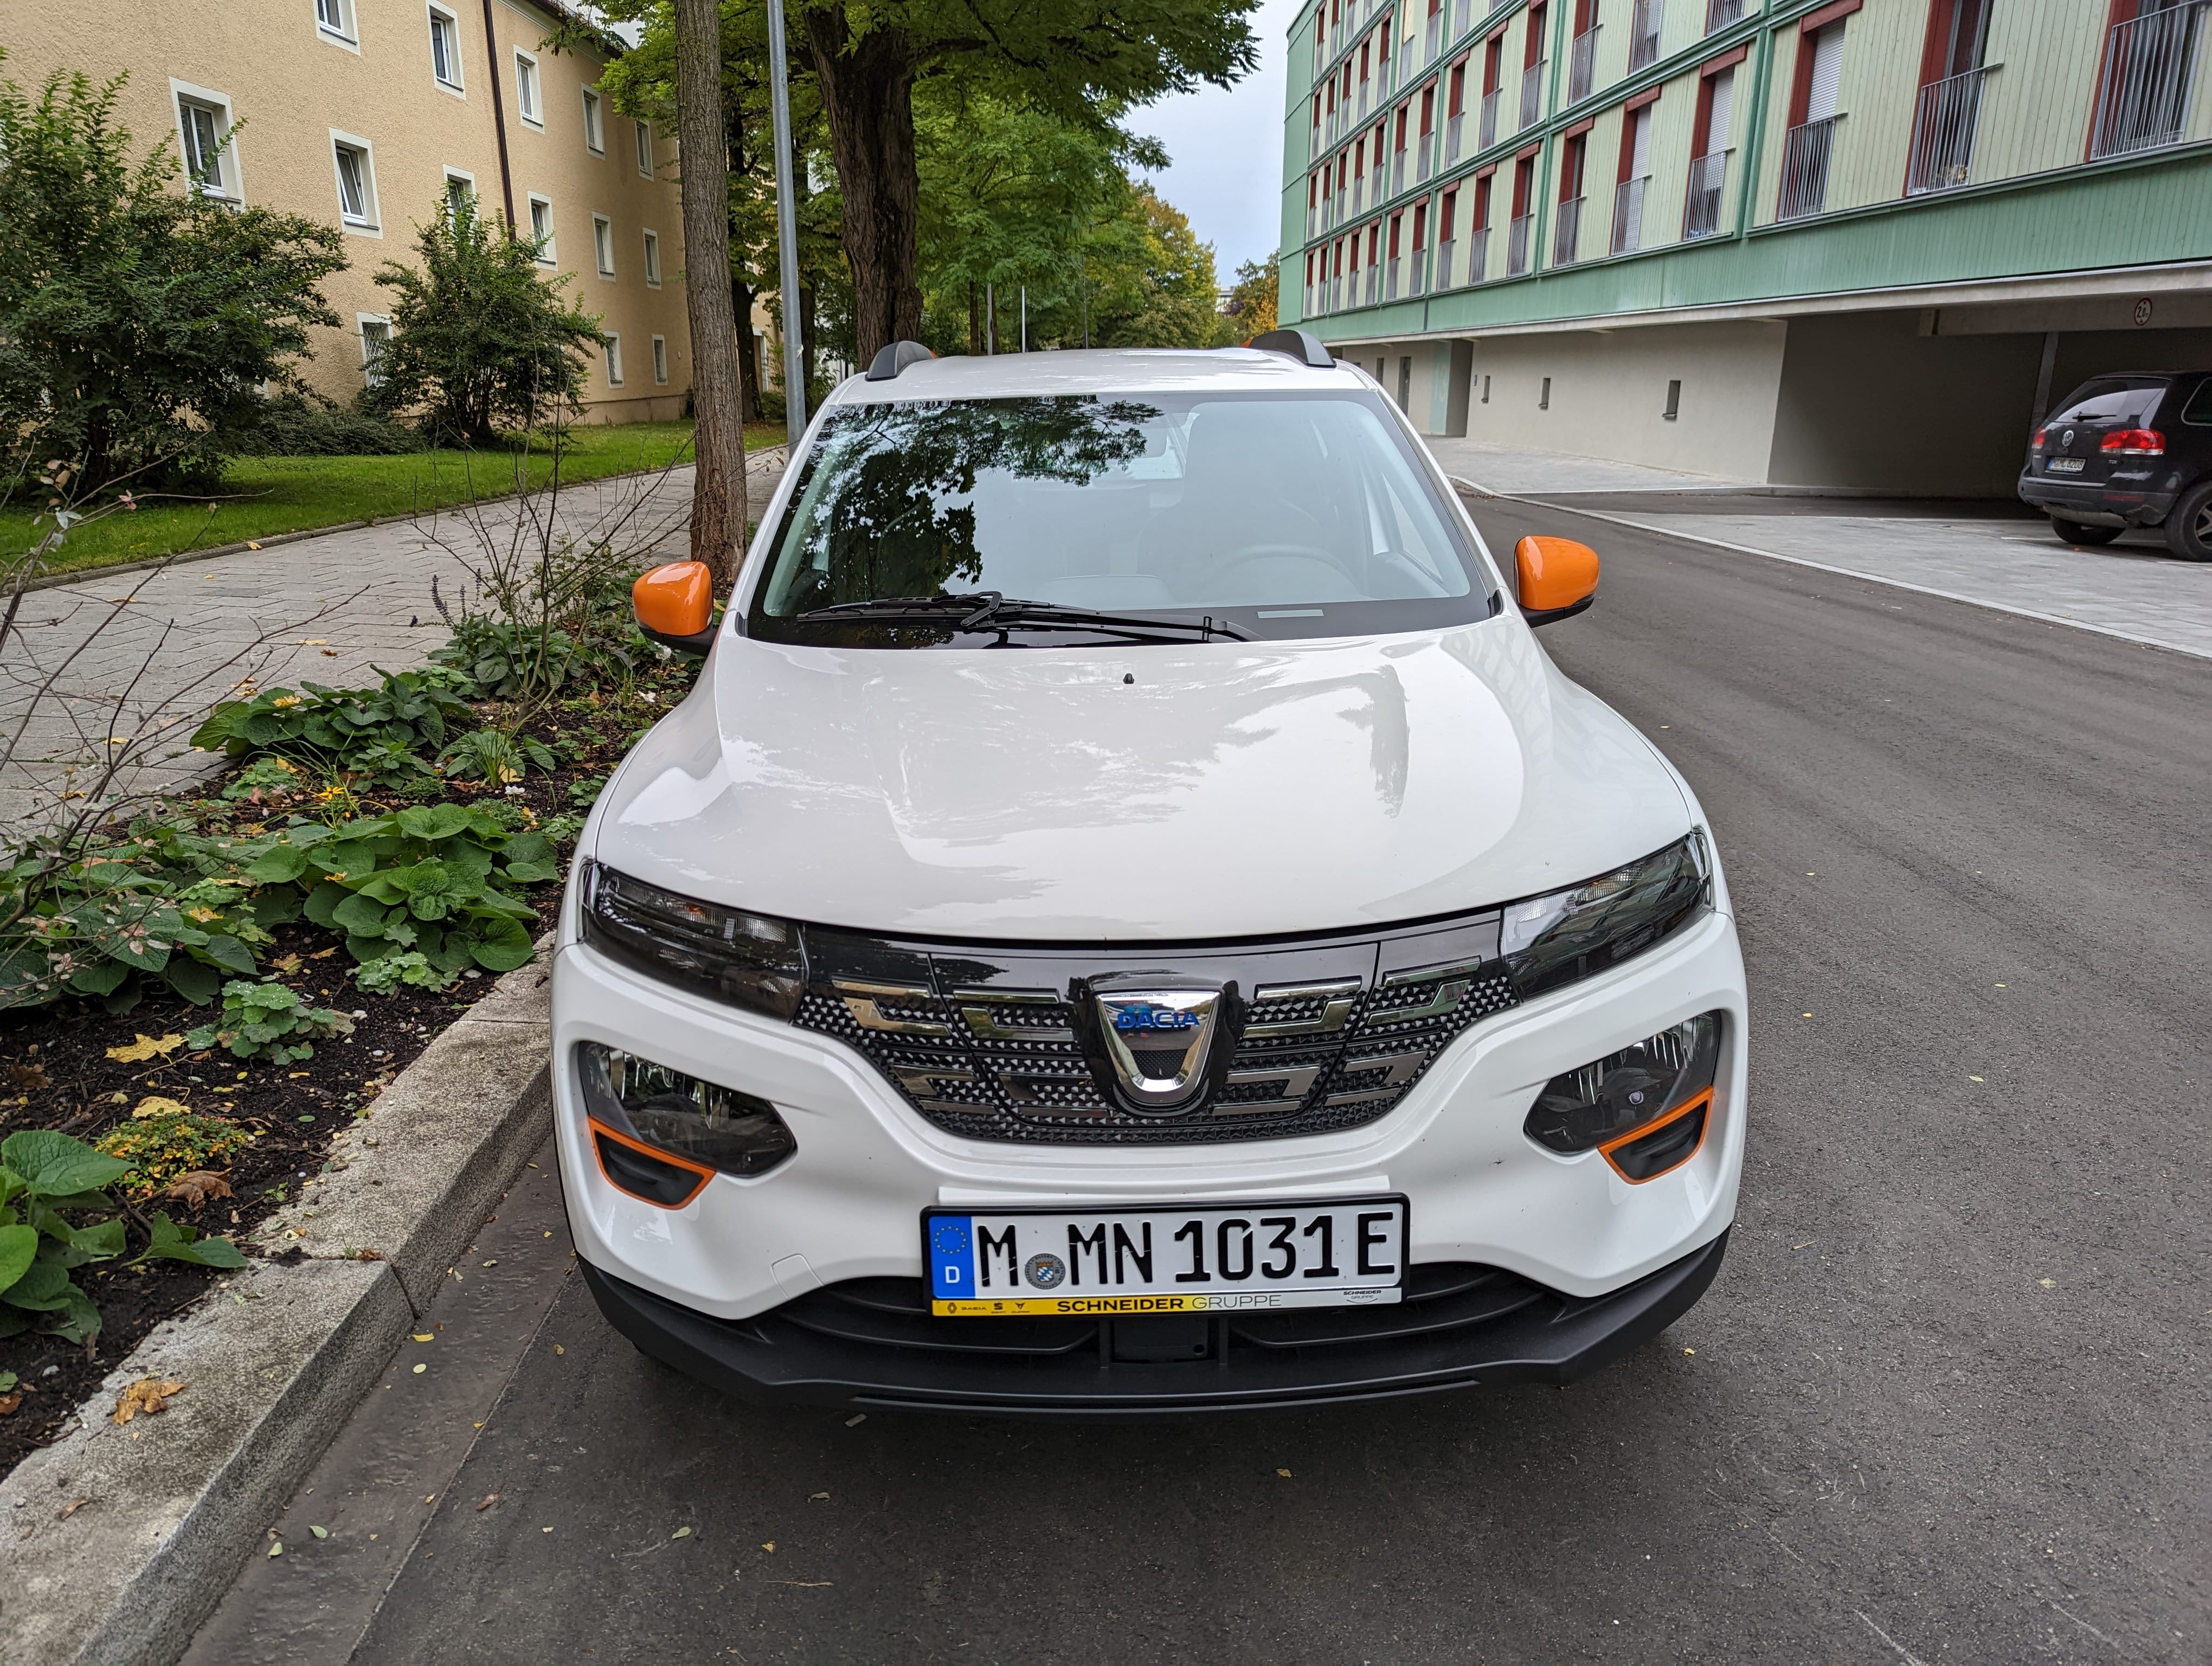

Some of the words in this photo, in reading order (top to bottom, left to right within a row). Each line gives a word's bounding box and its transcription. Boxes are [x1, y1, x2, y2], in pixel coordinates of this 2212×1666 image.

[1117, 1012, 1200, 1028] DACIA
[978, 1225, 1019, 1287] M
[1068, 1222, 1154, 1285] MN
[1174, 1215, 1339, 1283] 1031
[1358, 1212, 1395, 1276] E
[945, 1266, 960, 1283] D
[1057, 1298, 1184, 1312] SCHNEIDER
[1192, 1295, 1282, 1309] GRUPPE
